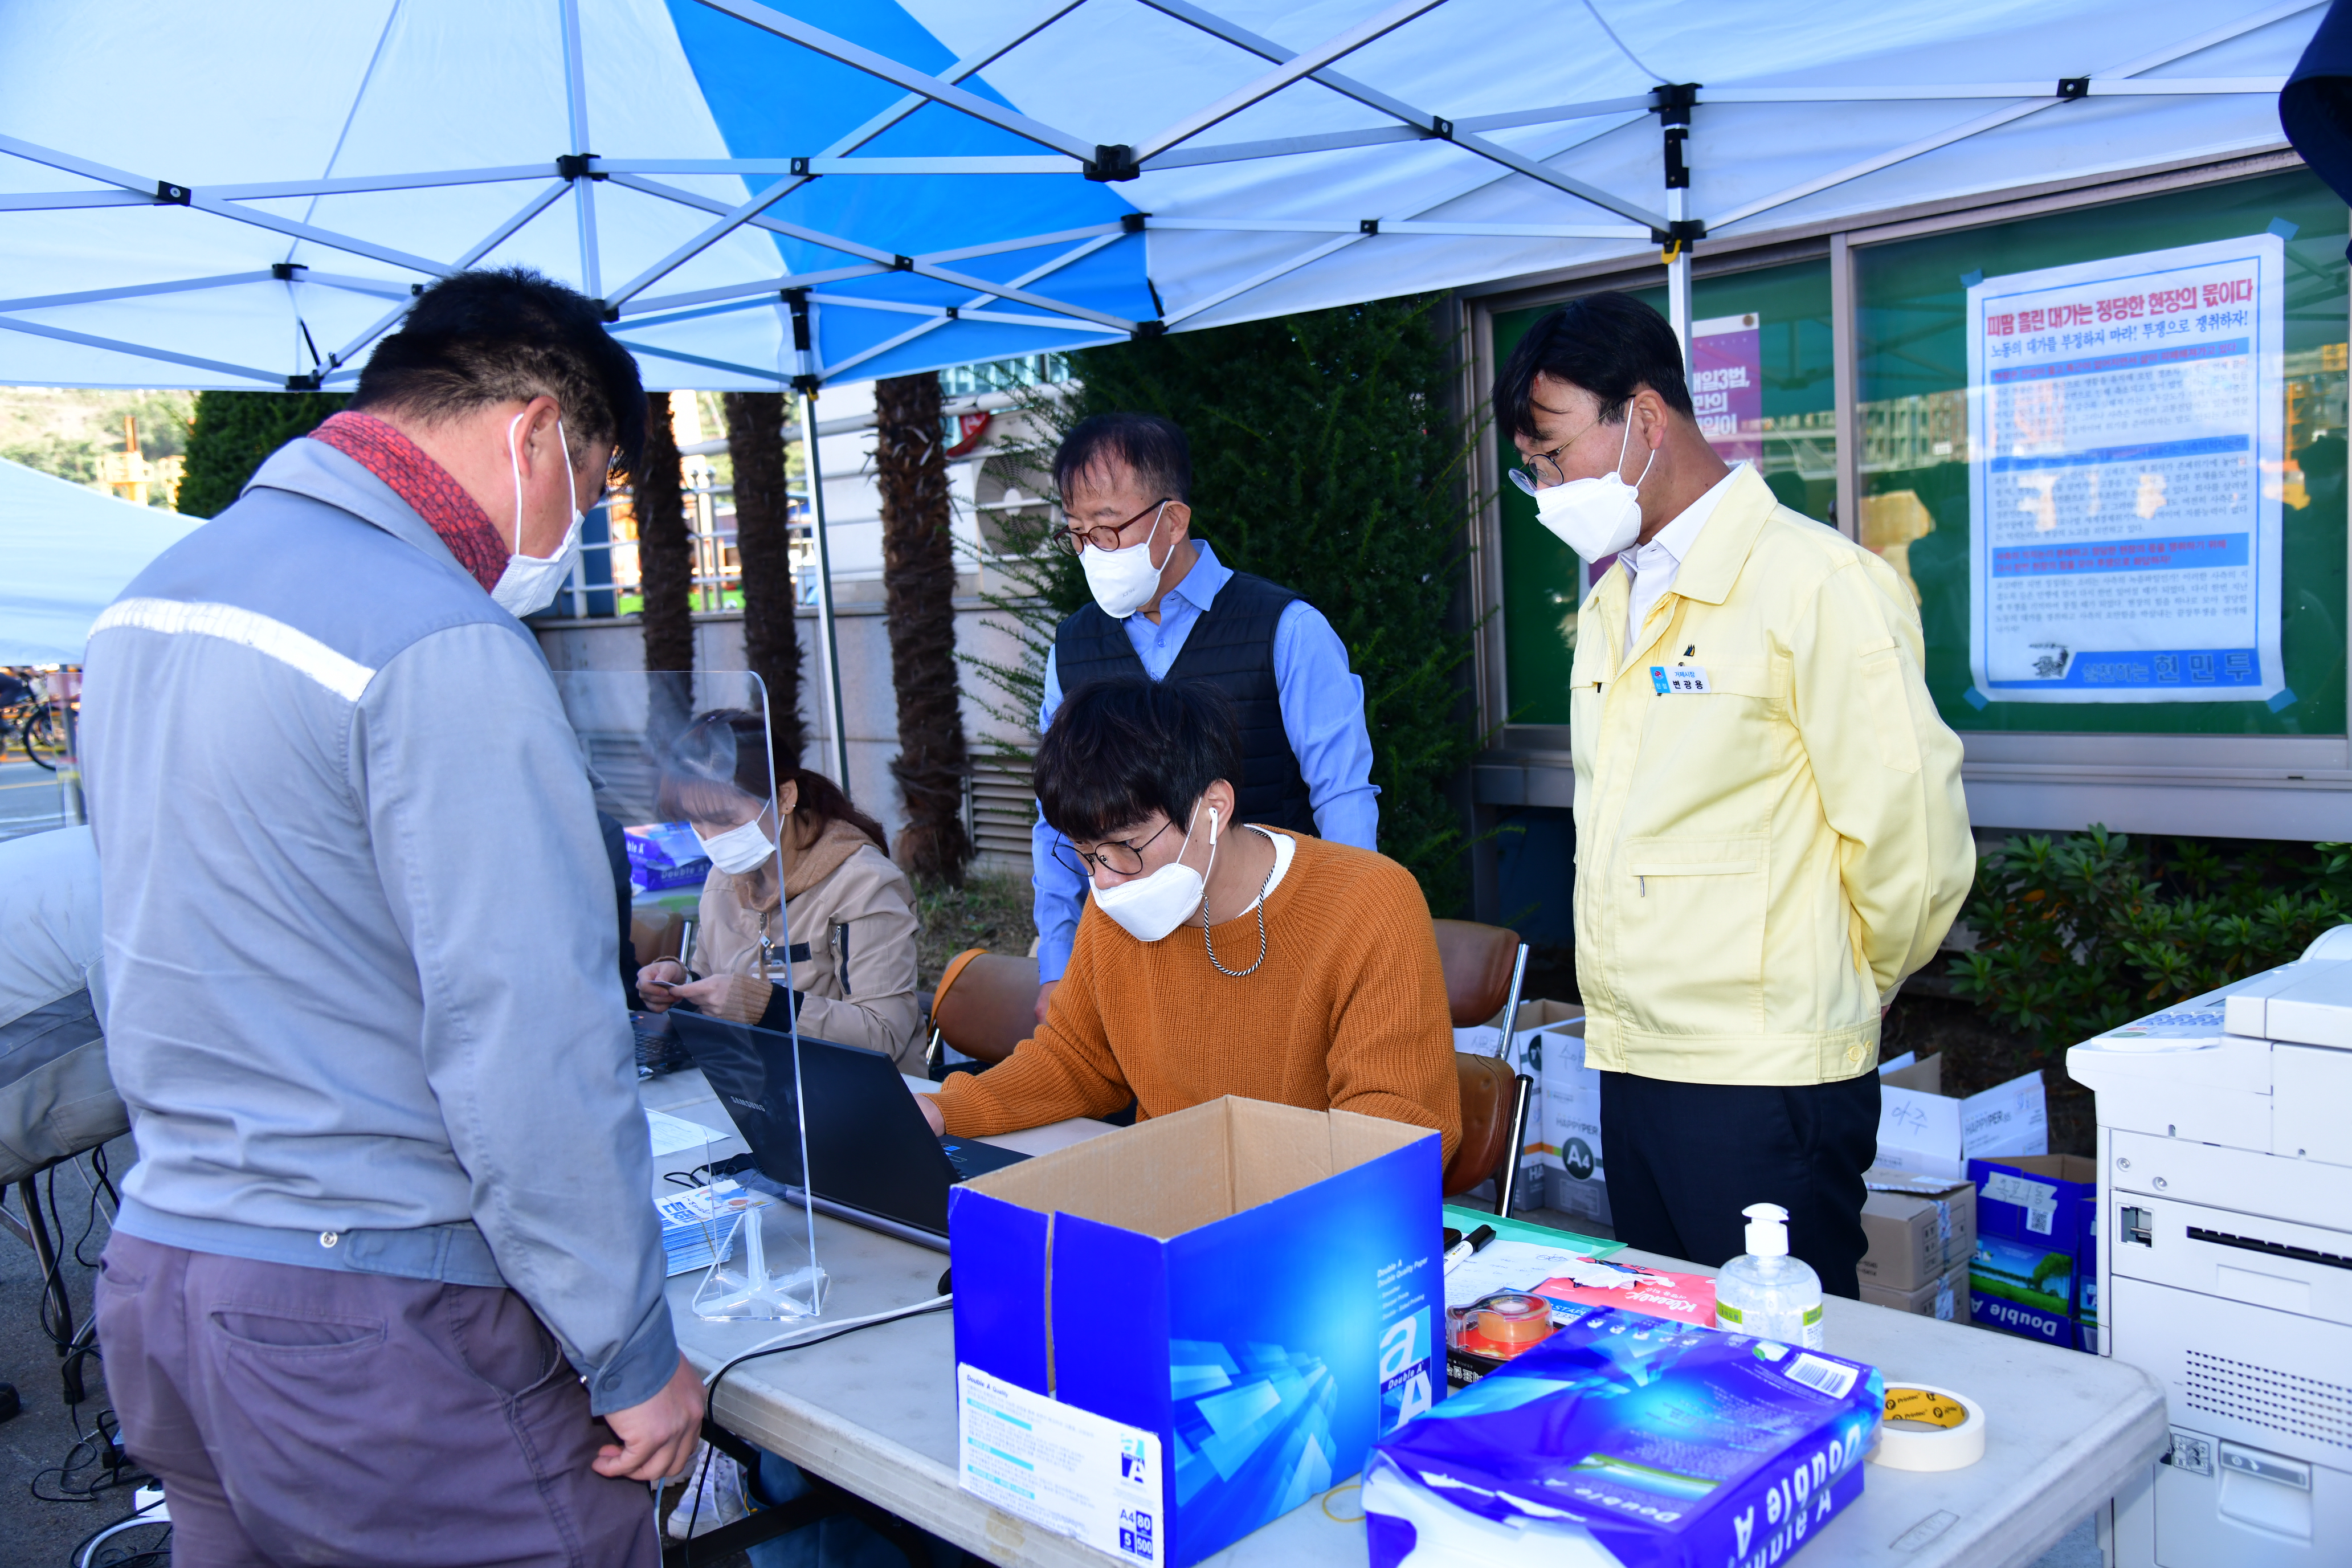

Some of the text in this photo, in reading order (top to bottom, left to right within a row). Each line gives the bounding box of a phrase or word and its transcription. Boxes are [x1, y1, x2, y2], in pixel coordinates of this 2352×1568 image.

[1987, 278, 2253, 336] 피땀 흘린 대가는 정당한 현장의 몫이다
[1991, 310, 2248, 358] 노동의 대가를 부정하지 마라! 투쟁으로 쟁취하자!
[2219, 342, 2236, 355] 있다
[1672, 680, 1704, 689] 변광용
[730, 1095, 766, 1113] SAMSUNG
[1890, 1100, 1928, 1136] 아주
[1566, 1143, 1591, 1171] A4
[1377, 1259, 1403, 1279] Double A
[1377, 1256, 1428, 1289] Double Quality Paper
[1645, 1287, 1660, 1295] 티슈
[1553, 1305, 1587, 1316] STAPL
[1624, 1291, 1697, 1313] Kleenex
[1970, 1297, 2058, 1337] Double A
[967, 1374, 985, 1389] Double
[993, 1385, 1009, 1398] Quality
[1388, 1367, 1415, 1390] Double
[1897, 1394, 1919, 1404] Printec
[1904, 1410, 1926, 1420] Printec
[1766, 1424, 1861, 1525] Double
[1574, 1486, 1683, 1524] Double
[1120, 1509, 1134, 1524] A4
[1137, 1513, 1151, 1531] 80
[1124, 1533, 1132, 1547] 5
[1733, 1504, 1755, 1561] A
[1137, 1538, 1152, 1555] 500
